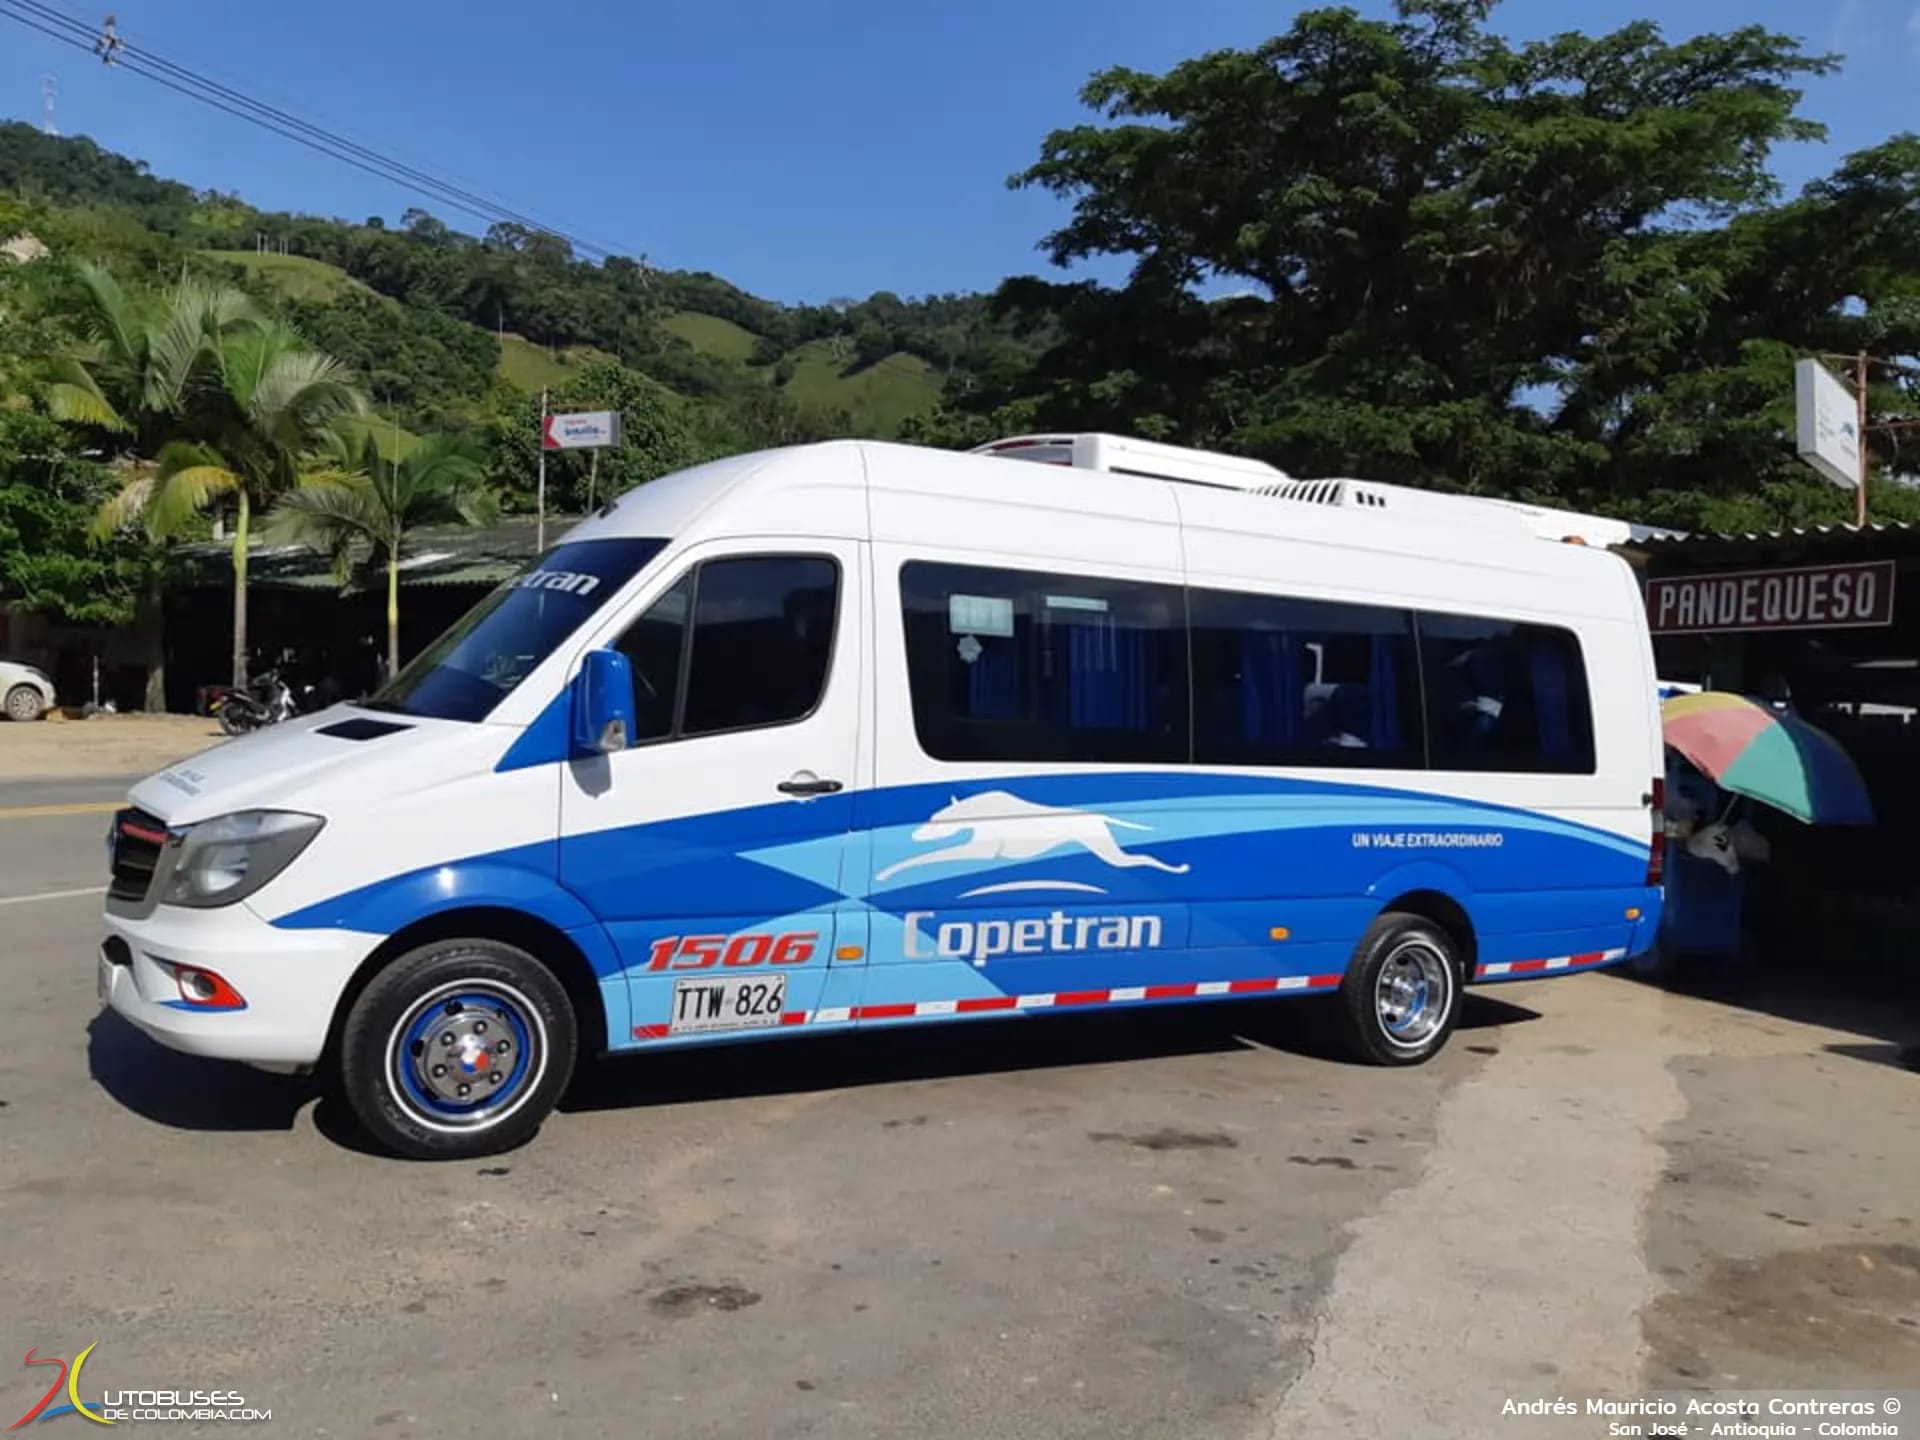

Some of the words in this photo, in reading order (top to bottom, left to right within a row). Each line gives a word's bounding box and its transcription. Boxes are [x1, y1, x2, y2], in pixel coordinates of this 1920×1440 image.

[1658, 571, 1876, 627] PANDEQUESO
[1352, 832, 1370, 848] UN
[1373, 832, 1405, 848] VIAJE
[1407, 832, 1504, 848] EXTRAORDINARIO
[648, 931, 819, 972] 1506
[904, 911, 1161, 967] Copetran
[677, 985, 725, 1021] TTW
[735, 983, 784, 1016] 826
